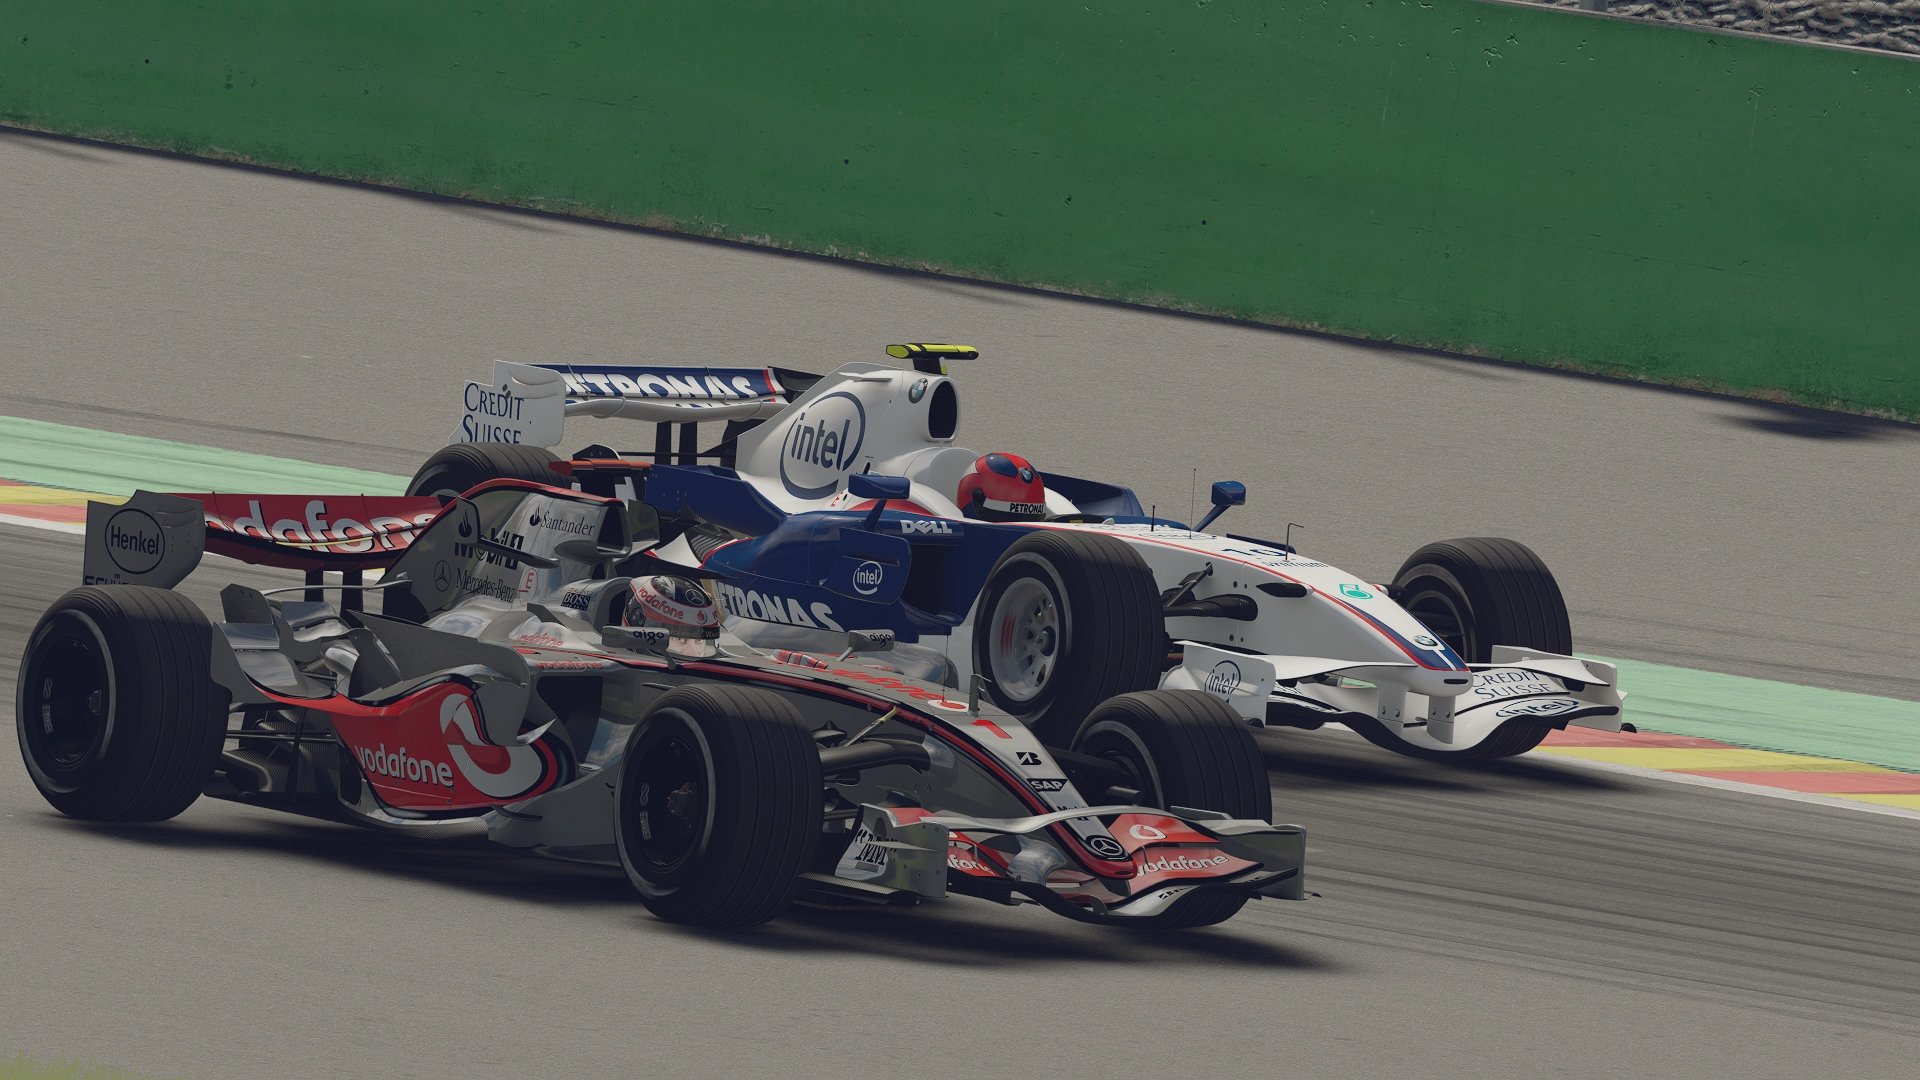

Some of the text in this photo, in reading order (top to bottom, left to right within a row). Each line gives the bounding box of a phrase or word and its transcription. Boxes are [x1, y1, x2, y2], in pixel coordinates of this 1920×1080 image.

[560, 372, 758, 397] ETRONAS
[464, 383, 525, 420] CREDIT
[790, 412, 851, 472] intel
[541, 510, 595, 536] Santander
[900, 519, 953, 534] DELL
[110, 525, 160, 555] Henkel
[456, 567, 516, 603] Mercedes-Benz
[856, 567, 878, 585] intel
[639, 586, 685, 618] vodafone
[716, 580, 846, 633] ETRONAS
[632, 629, 665, 646] aigo
[869, 632, 893, 648] aigo
[355, 743, 455, 787] vodafone
[1030, 780, 1063, 791] SAP
[1136, 855, 1230, 877] vodafone
